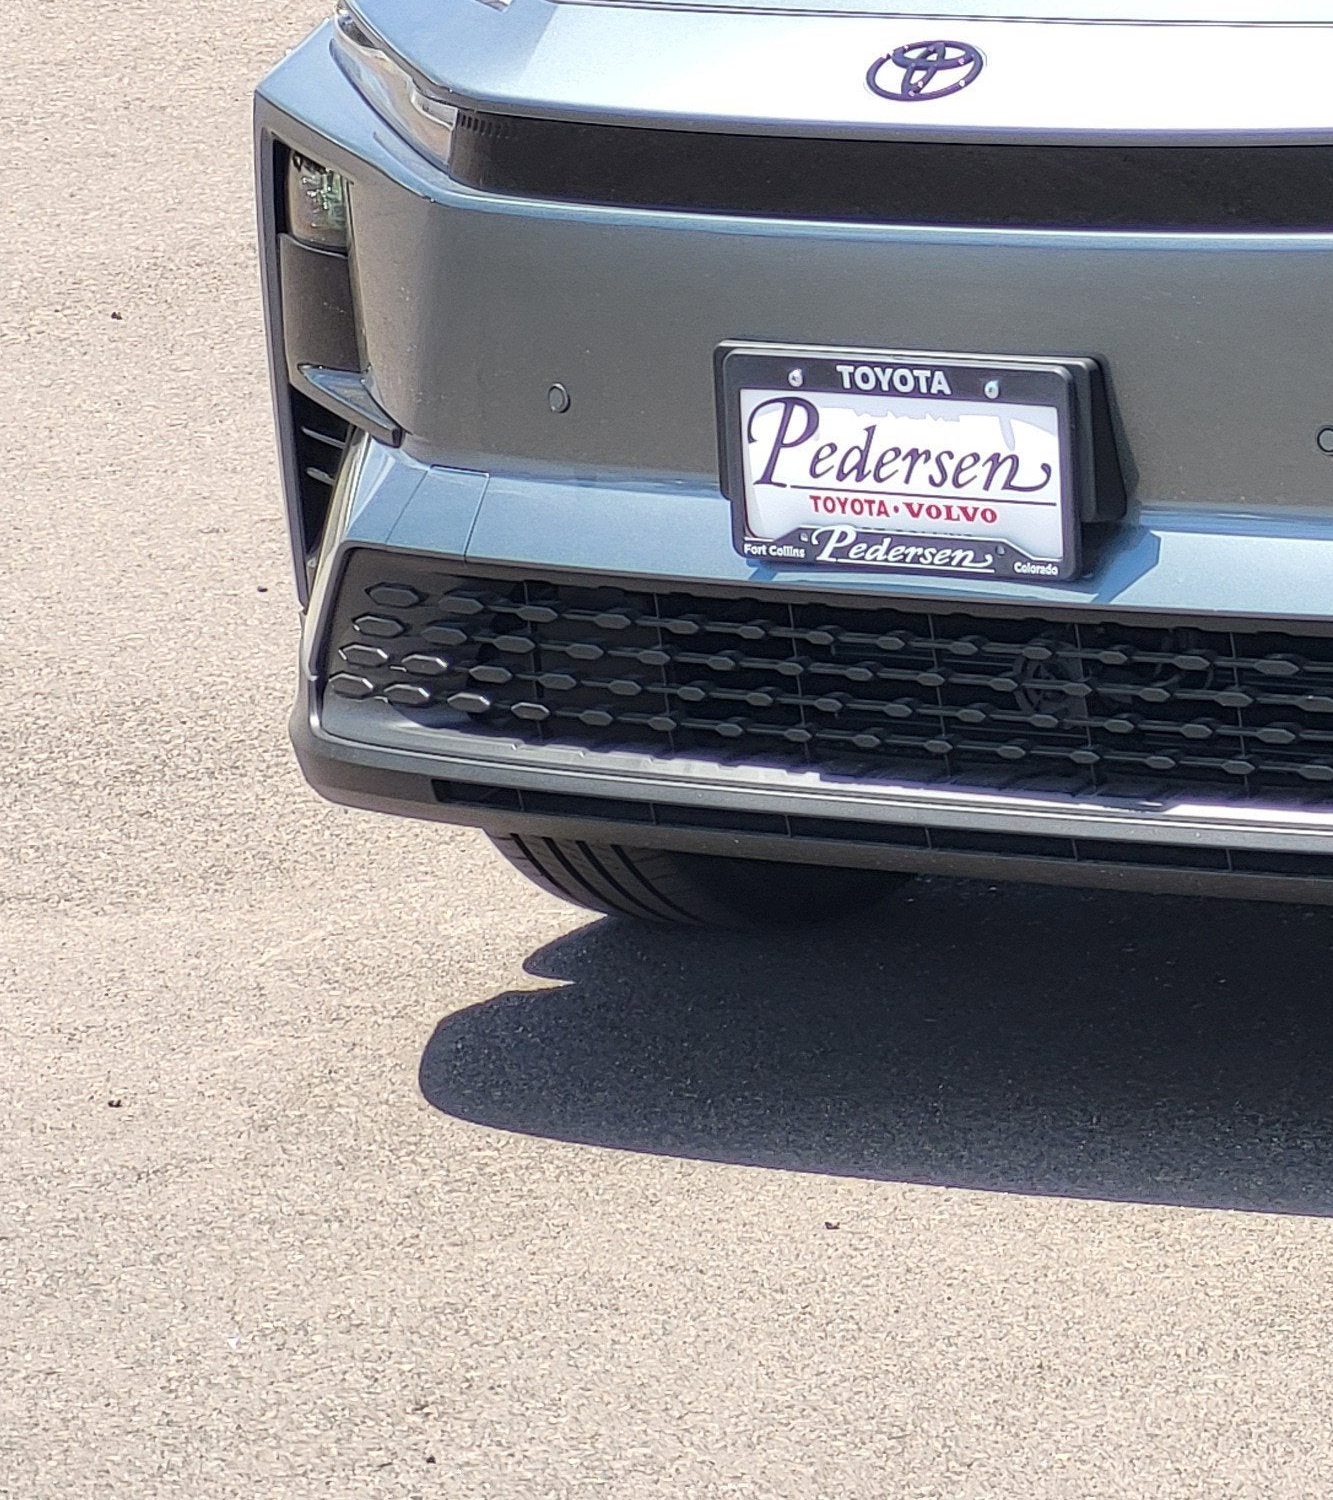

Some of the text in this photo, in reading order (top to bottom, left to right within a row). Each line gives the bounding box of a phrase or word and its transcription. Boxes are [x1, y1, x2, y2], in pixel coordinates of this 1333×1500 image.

[836, 364, 952, 396] TOYOTA
[748, 396, 1052, 492] Pedersen
[809, 495, 998, 524] TOYOTA VOLVO
[743, 543, 805, 558] Fort Collins
[811, 524, 994, 568] Pedersen
[1013, 561, 1059, 576] Colorado
